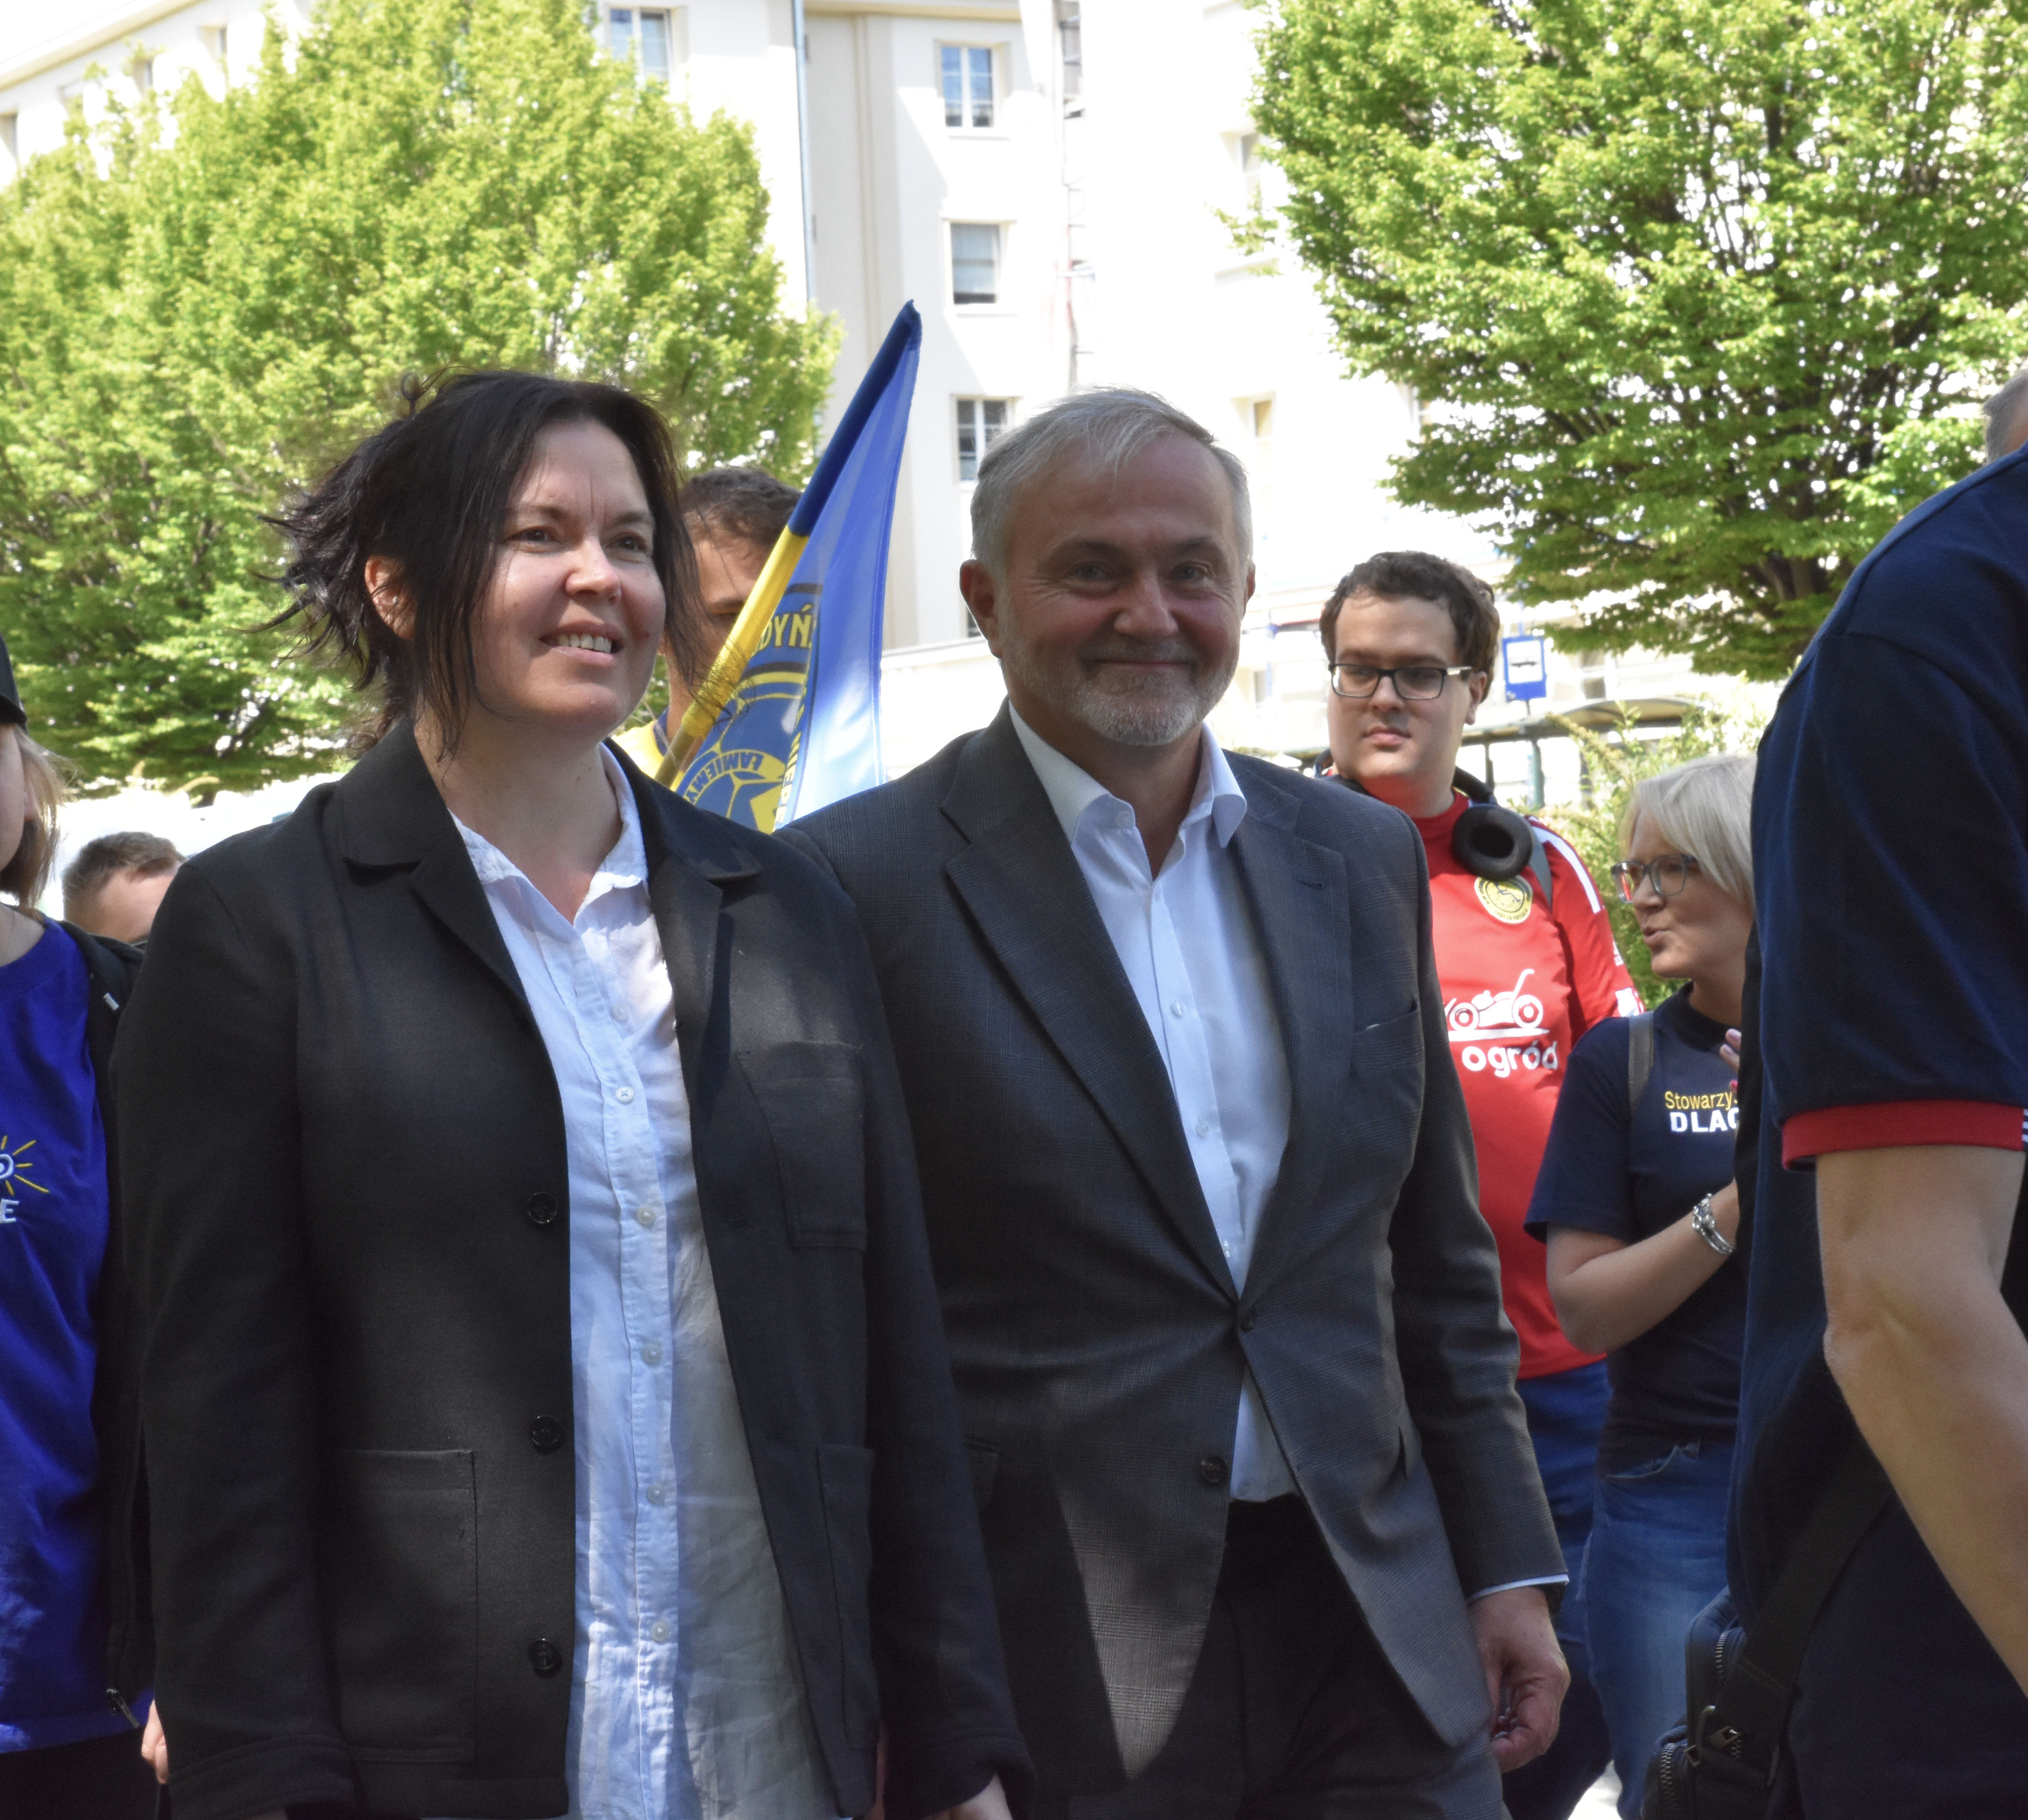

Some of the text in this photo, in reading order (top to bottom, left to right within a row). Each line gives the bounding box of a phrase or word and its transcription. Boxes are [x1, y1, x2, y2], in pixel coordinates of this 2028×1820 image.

[758, 603, 812, 650] DYŃ
[1462, 1040, 1558, 1078] ogród
[1665, 1091, 1737, 1110] Stowarzy
